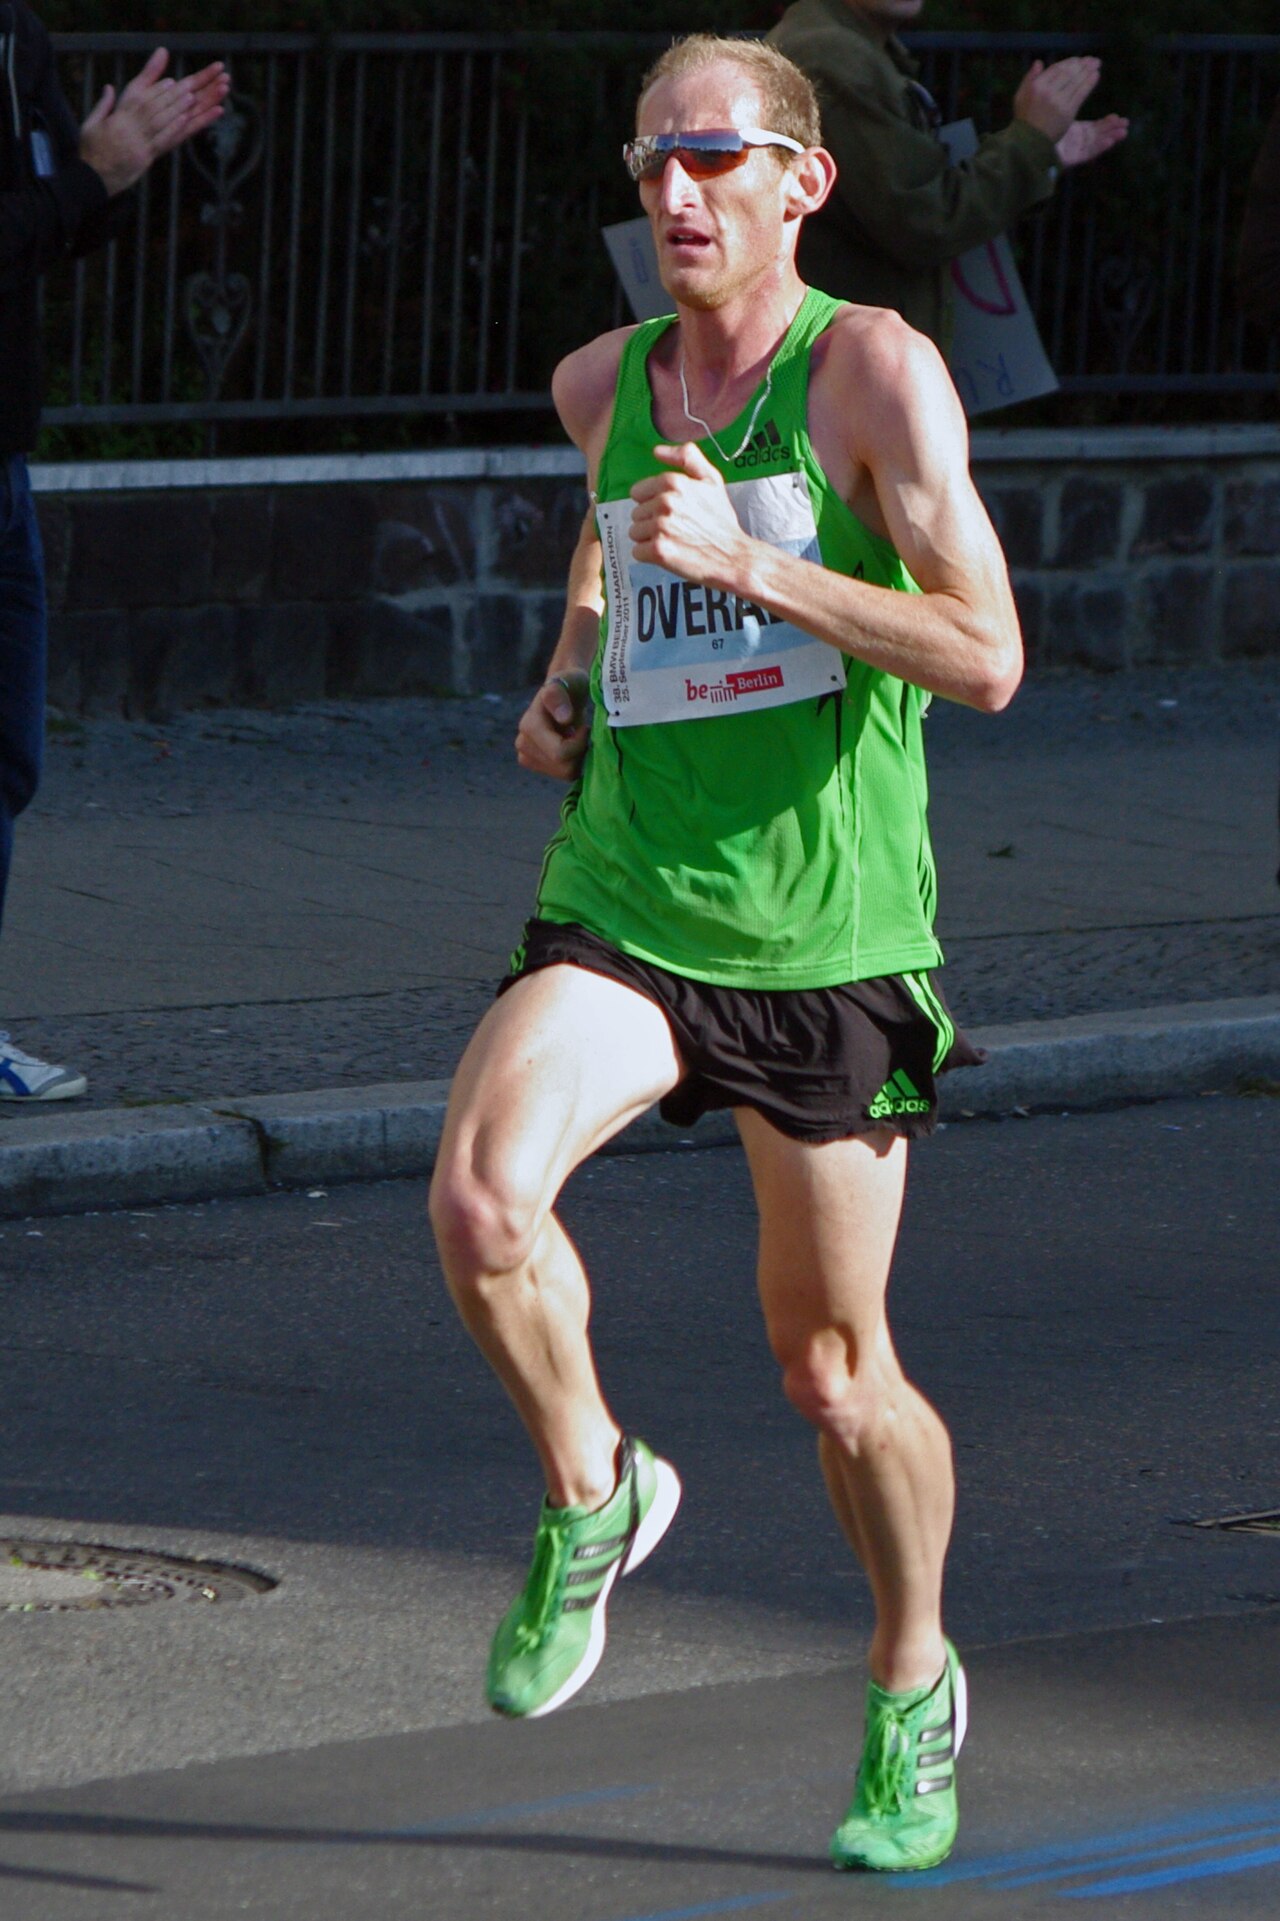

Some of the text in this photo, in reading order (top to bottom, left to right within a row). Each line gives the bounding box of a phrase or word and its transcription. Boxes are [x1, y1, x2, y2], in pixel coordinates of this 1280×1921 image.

[606, 525, 623, 650] BERLIN-MARATHON
[622, 597, 630, 621] 2011
[637, 580, 785, 643] OVERA
[618, 624, 628, 684] September
[711, 638, 725, 650] 67
[609, 652, 619, 683] BMW
[685, 674, 778, 701] be Berlin
[869, 1098, 929, 1118] adidas
